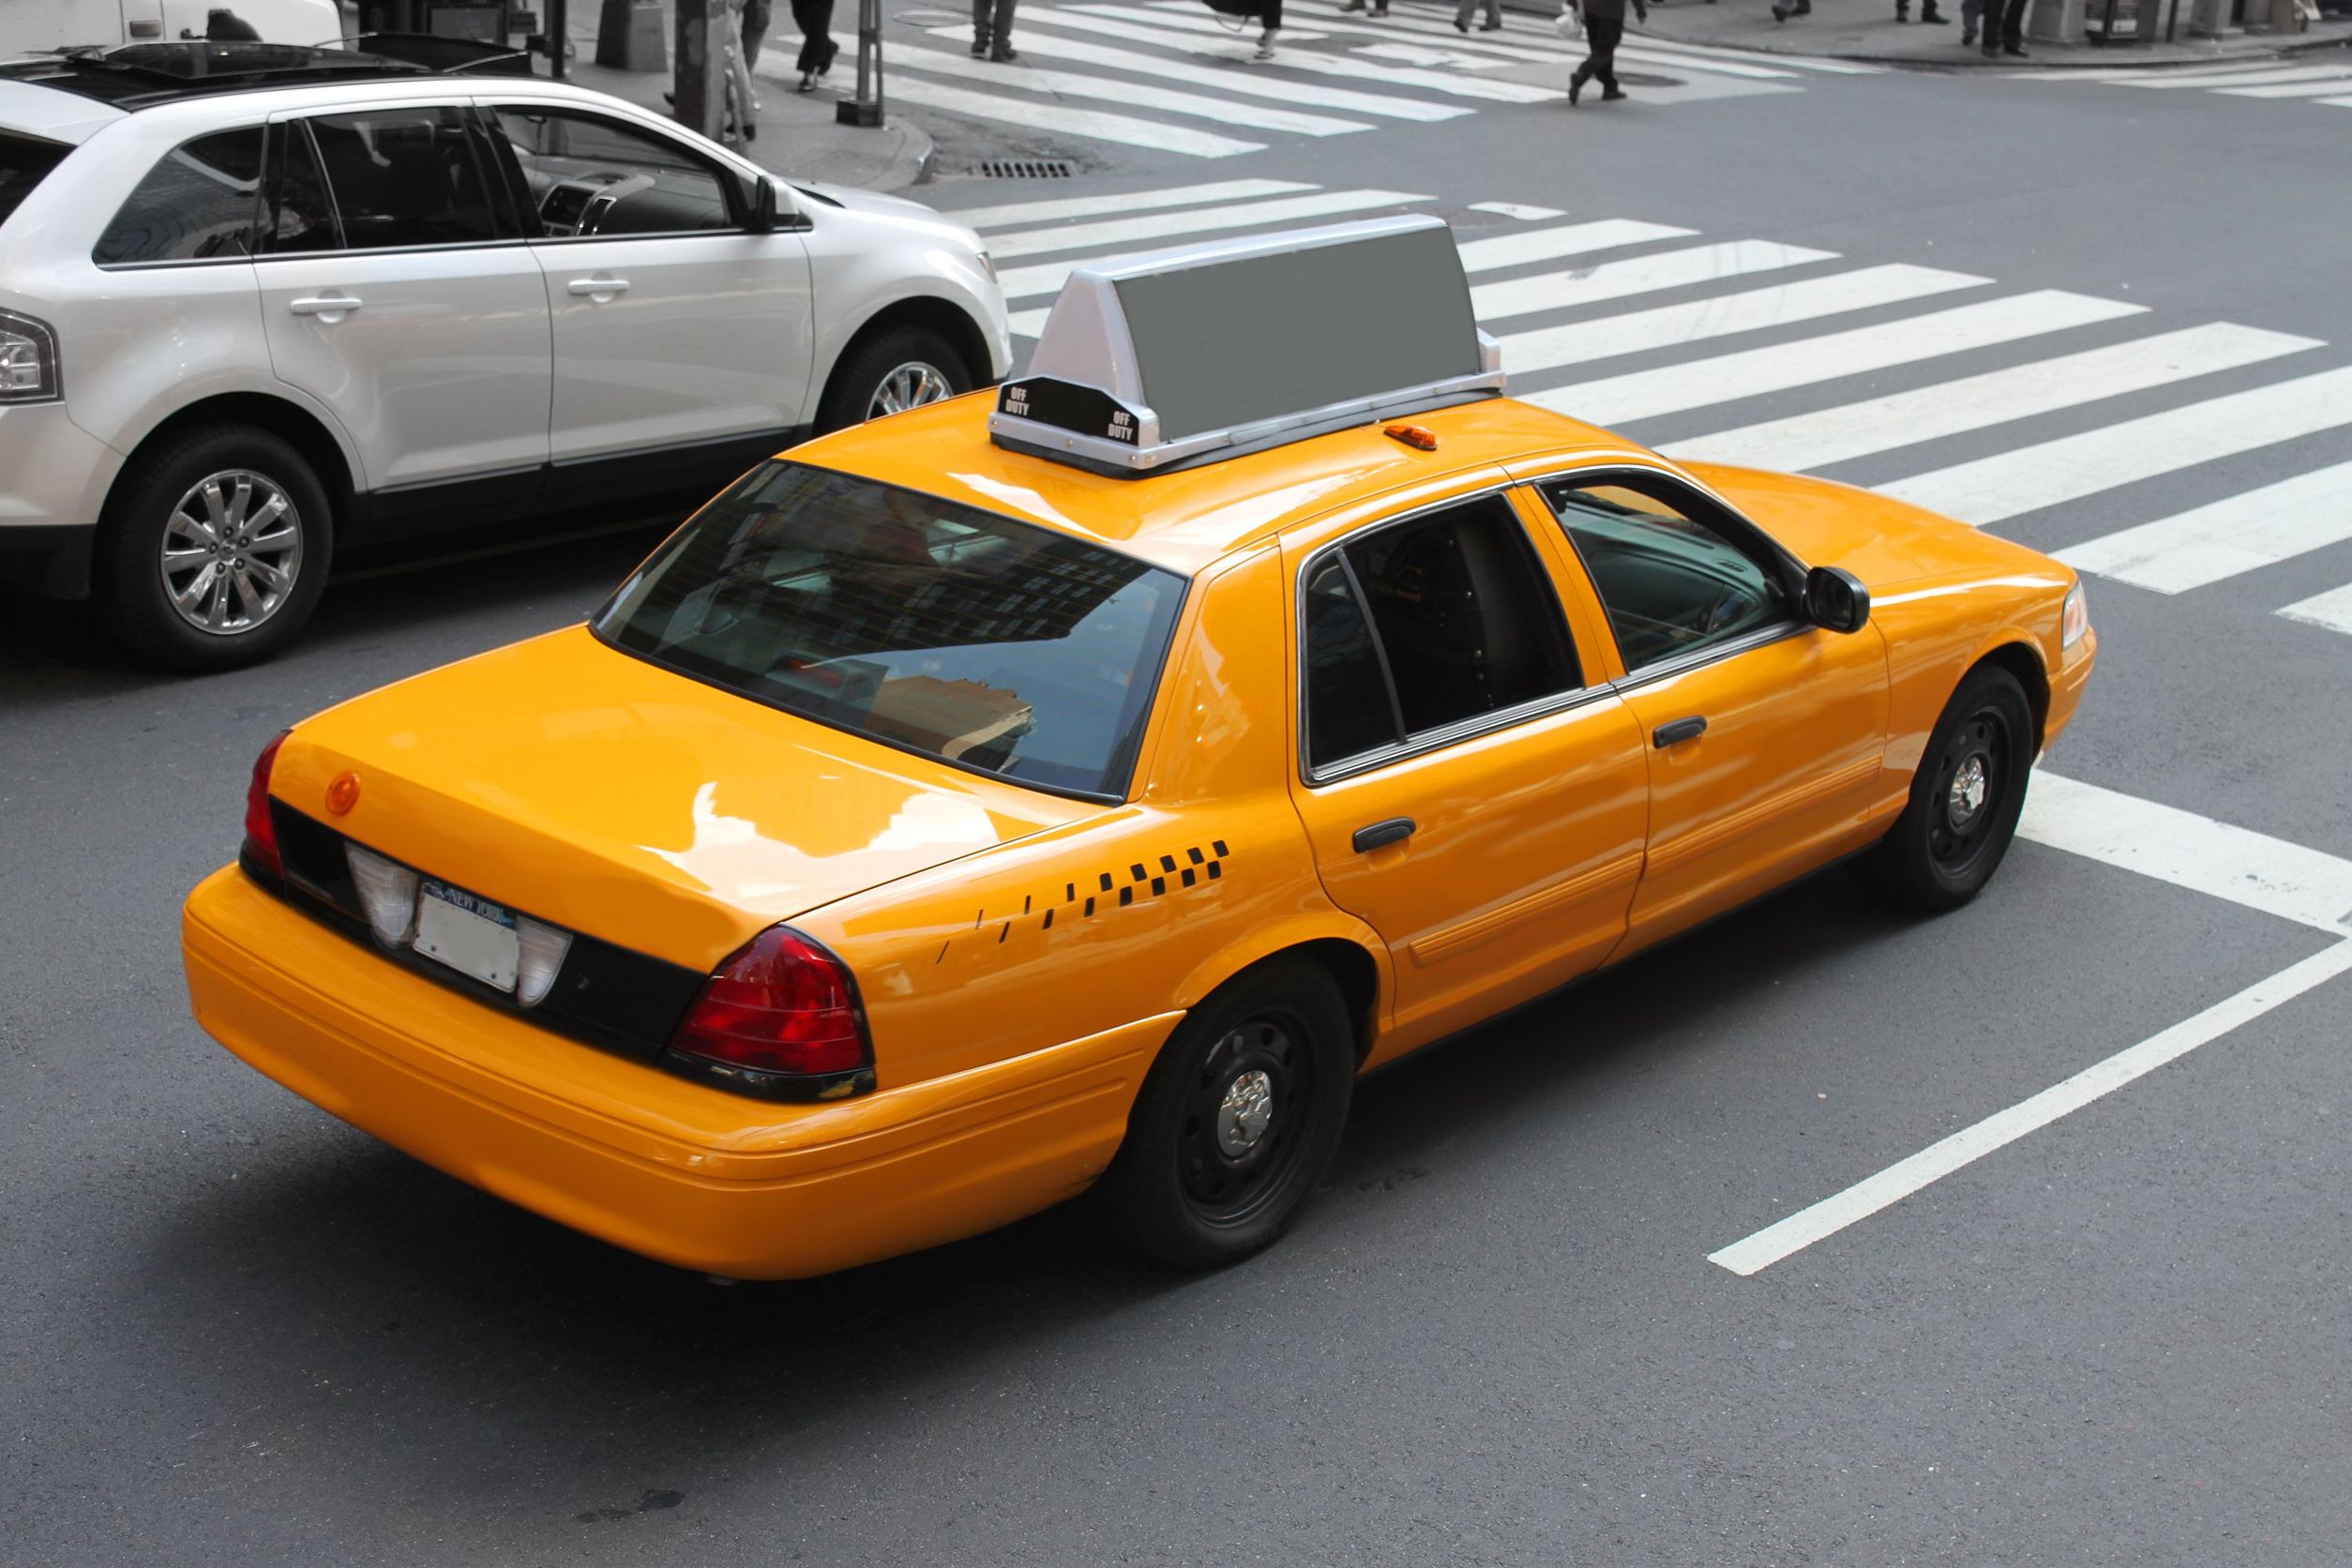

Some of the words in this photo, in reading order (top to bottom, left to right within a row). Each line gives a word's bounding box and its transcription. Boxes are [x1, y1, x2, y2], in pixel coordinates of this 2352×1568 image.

[1010, 386, 1027, 401] OFF
[1005, 400, 1030, 415] DUTY
[1113, 411, 1130, 426] OFF
[1108, 424, 1133, 441] DUTY
[449, 889, 473, 910] NEW
